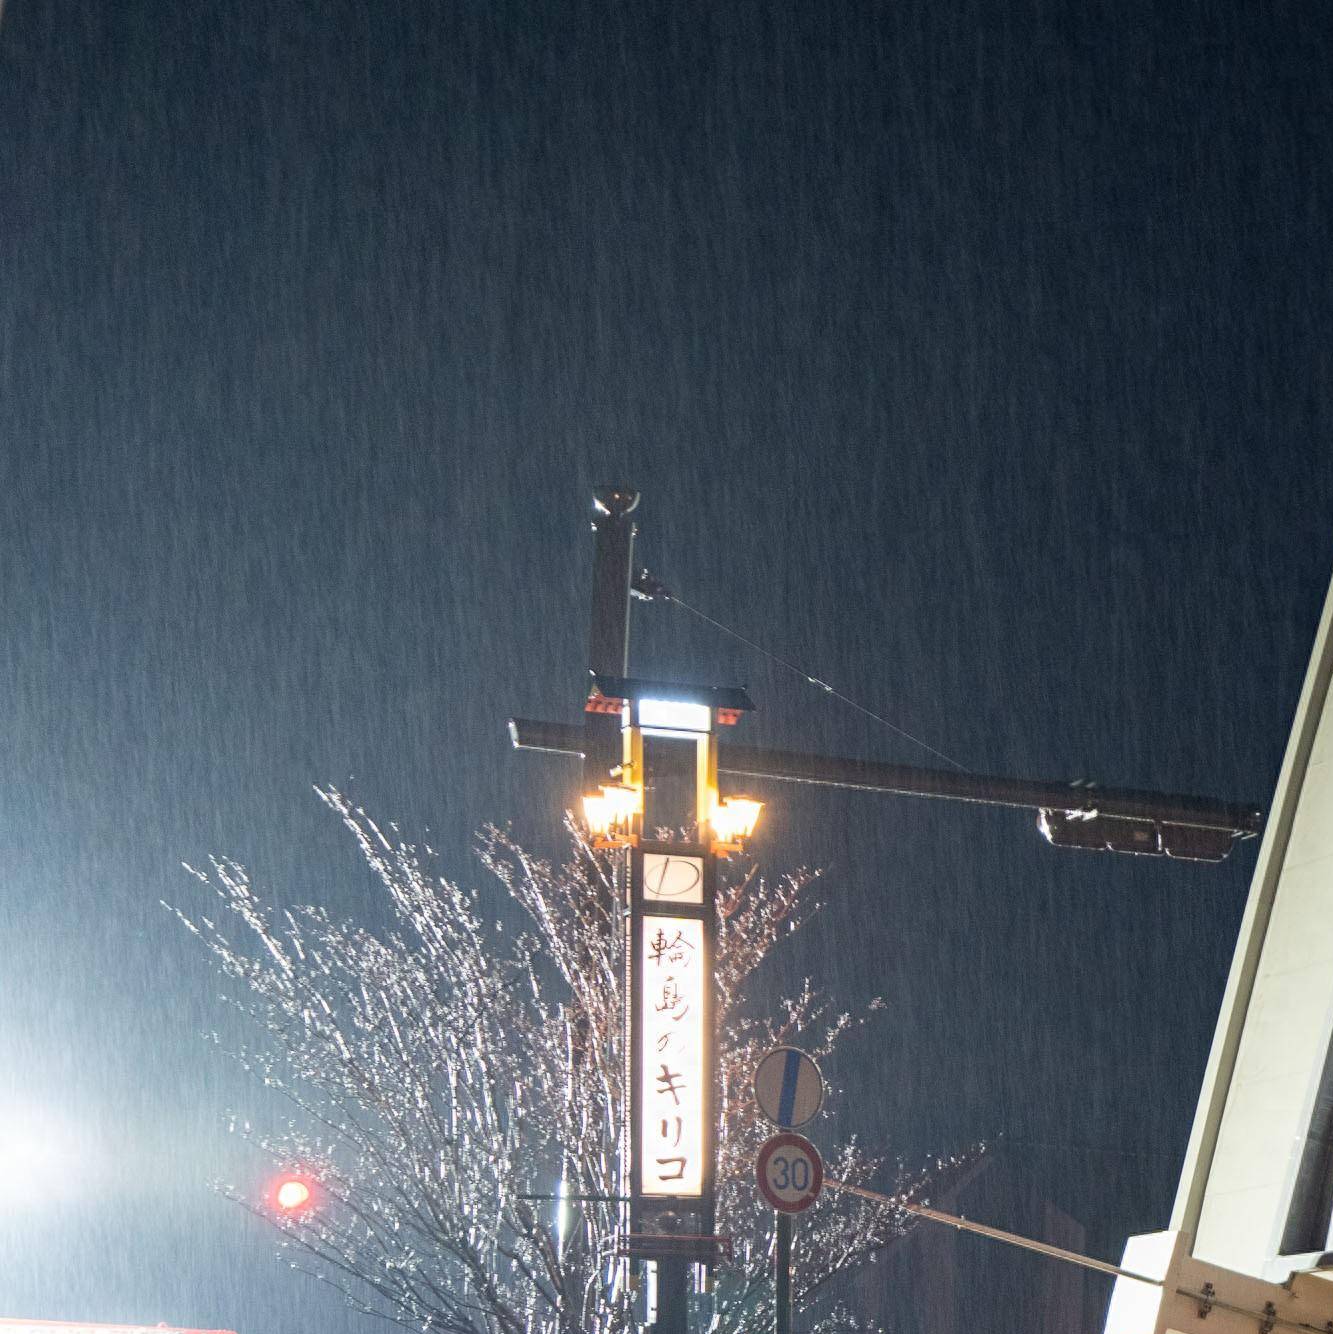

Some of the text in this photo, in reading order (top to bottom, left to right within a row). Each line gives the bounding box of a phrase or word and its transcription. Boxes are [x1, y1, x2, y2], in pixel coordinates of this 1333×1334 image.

[648, 927, 697, 1182] 輪島のキリコ
[773, 1156, 810, 1192] 30
